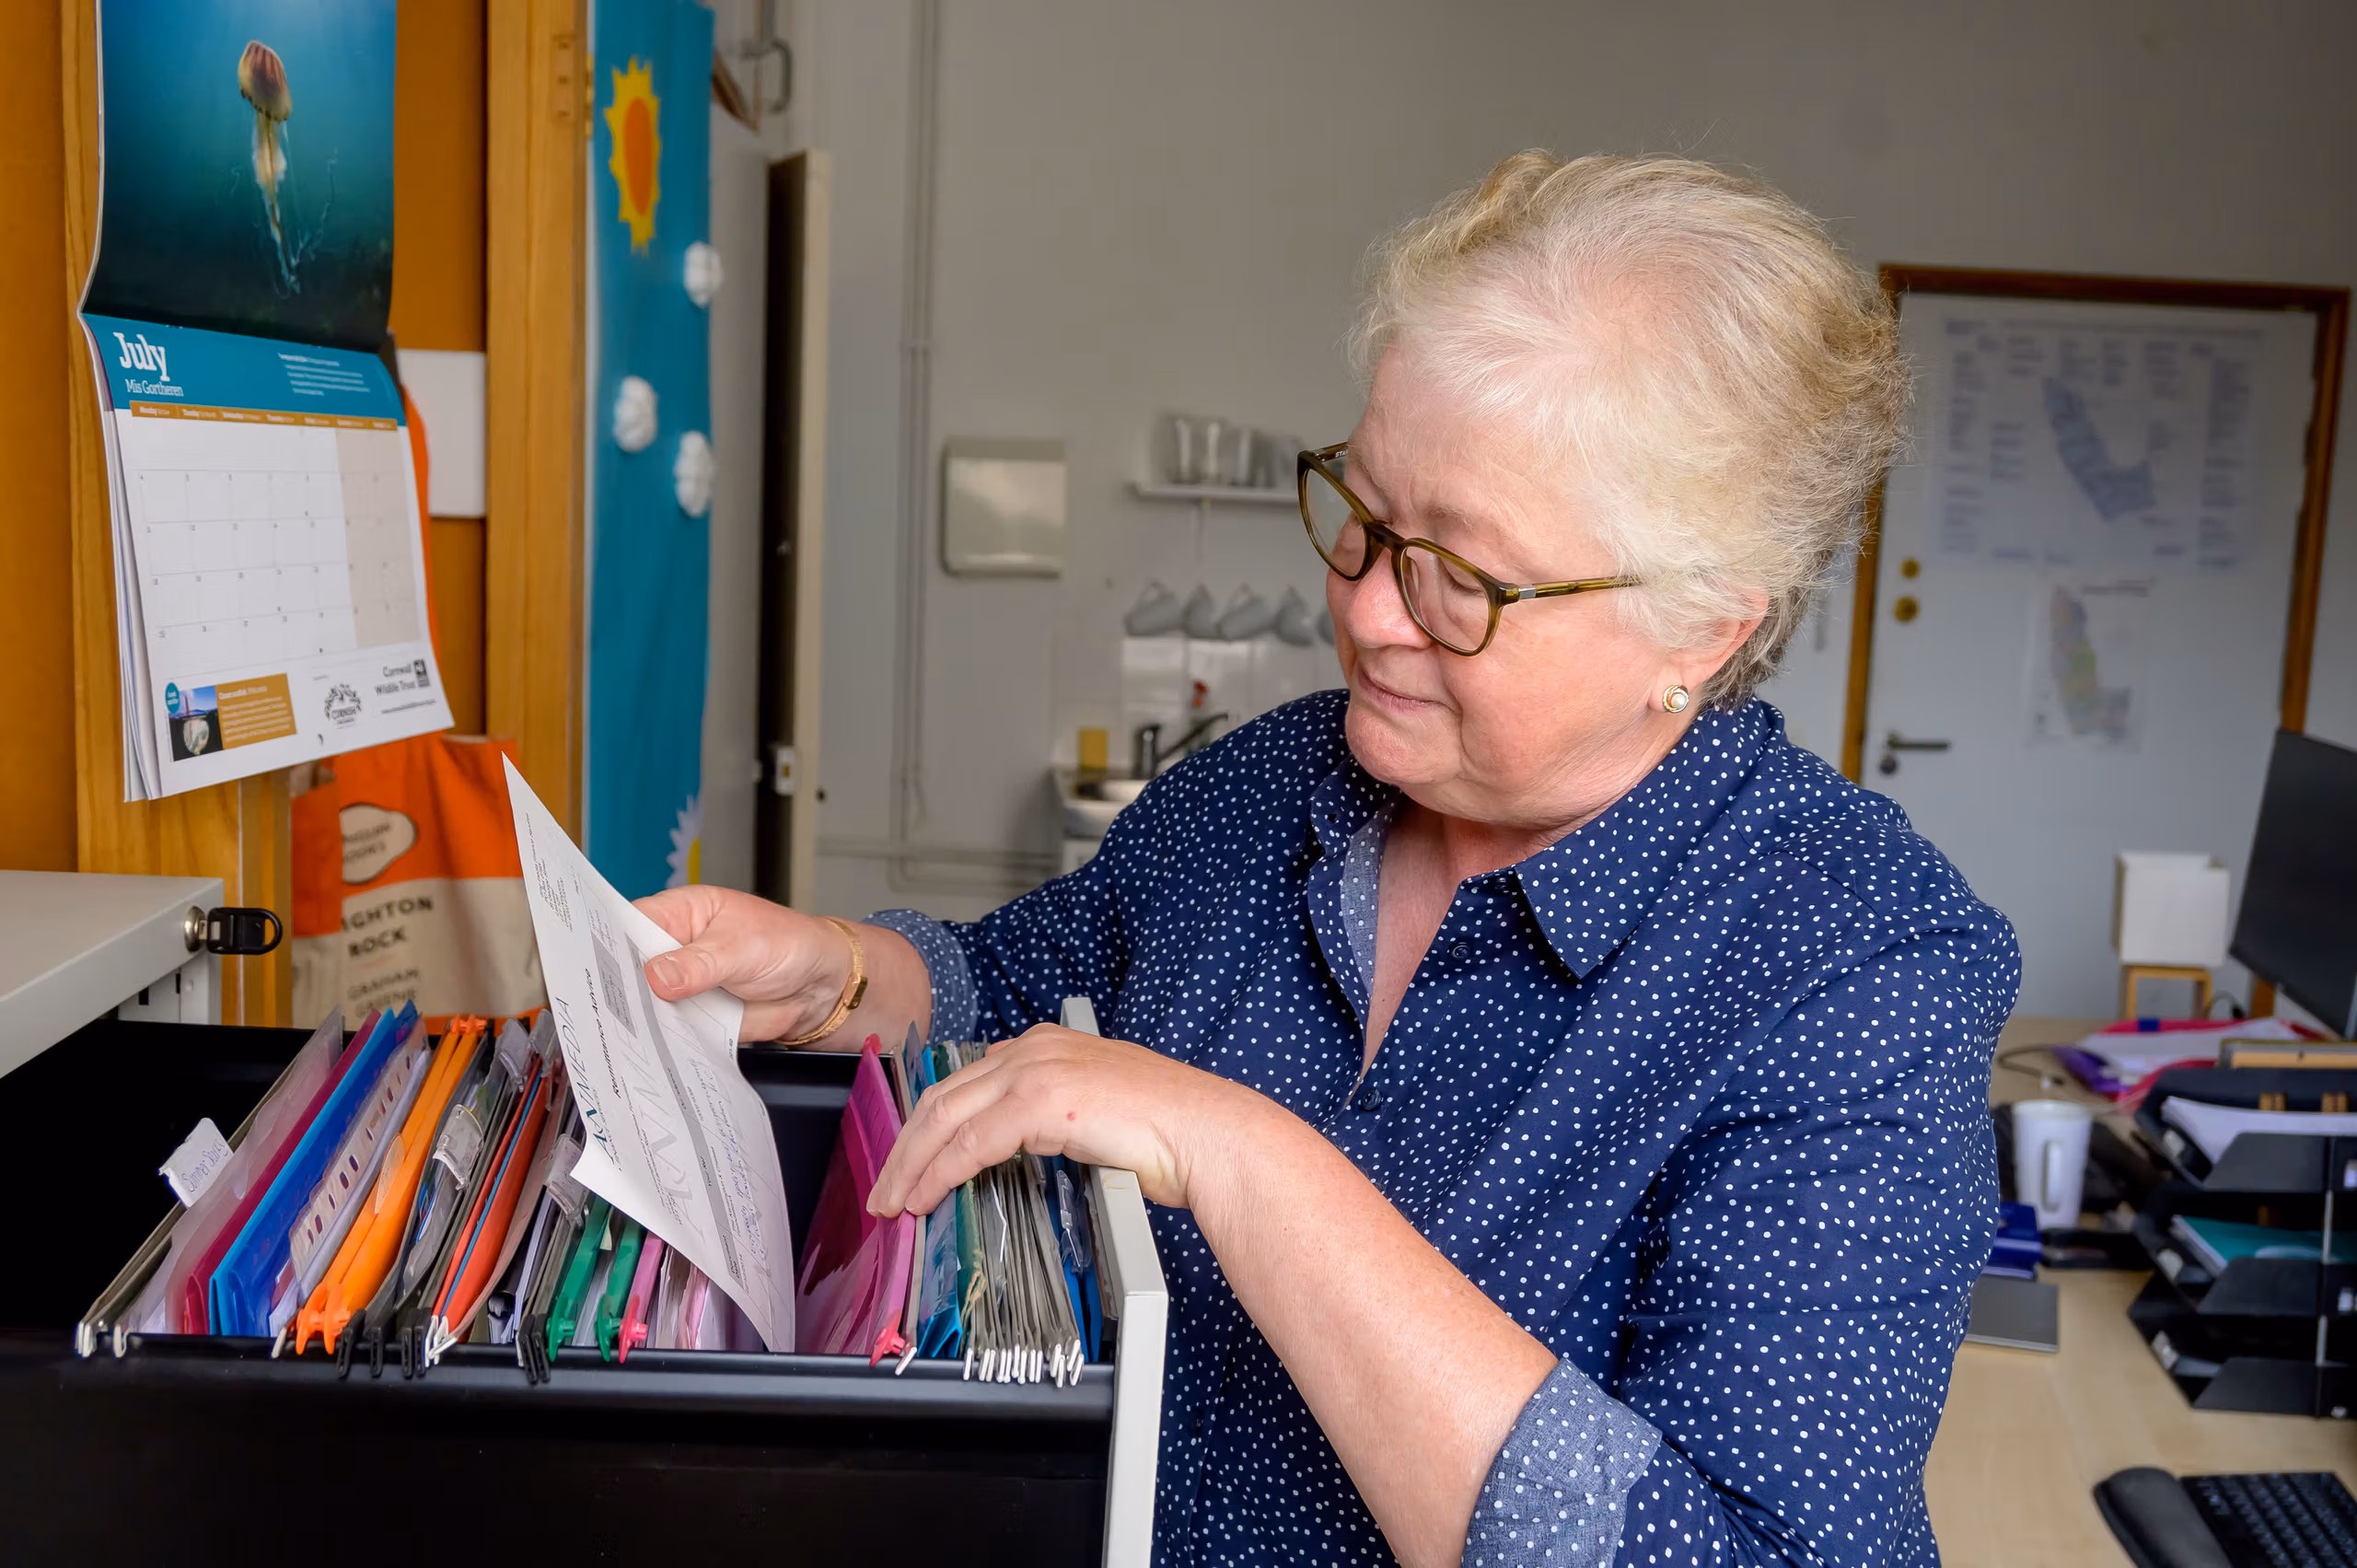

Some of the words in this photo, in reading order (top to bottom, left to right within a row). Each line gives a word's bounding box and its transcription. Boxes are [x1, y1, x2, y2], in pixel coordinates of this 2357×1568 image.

[113, 332, 170, 382] July
[125, 378, 143, 394] Mis
[382, 664, 412, 678] Cornwall
[348, 926, 407, 958] ROCK
[586, 969, 600, 1016] Advice
[597, 1018, 621, 1098] Remittance
